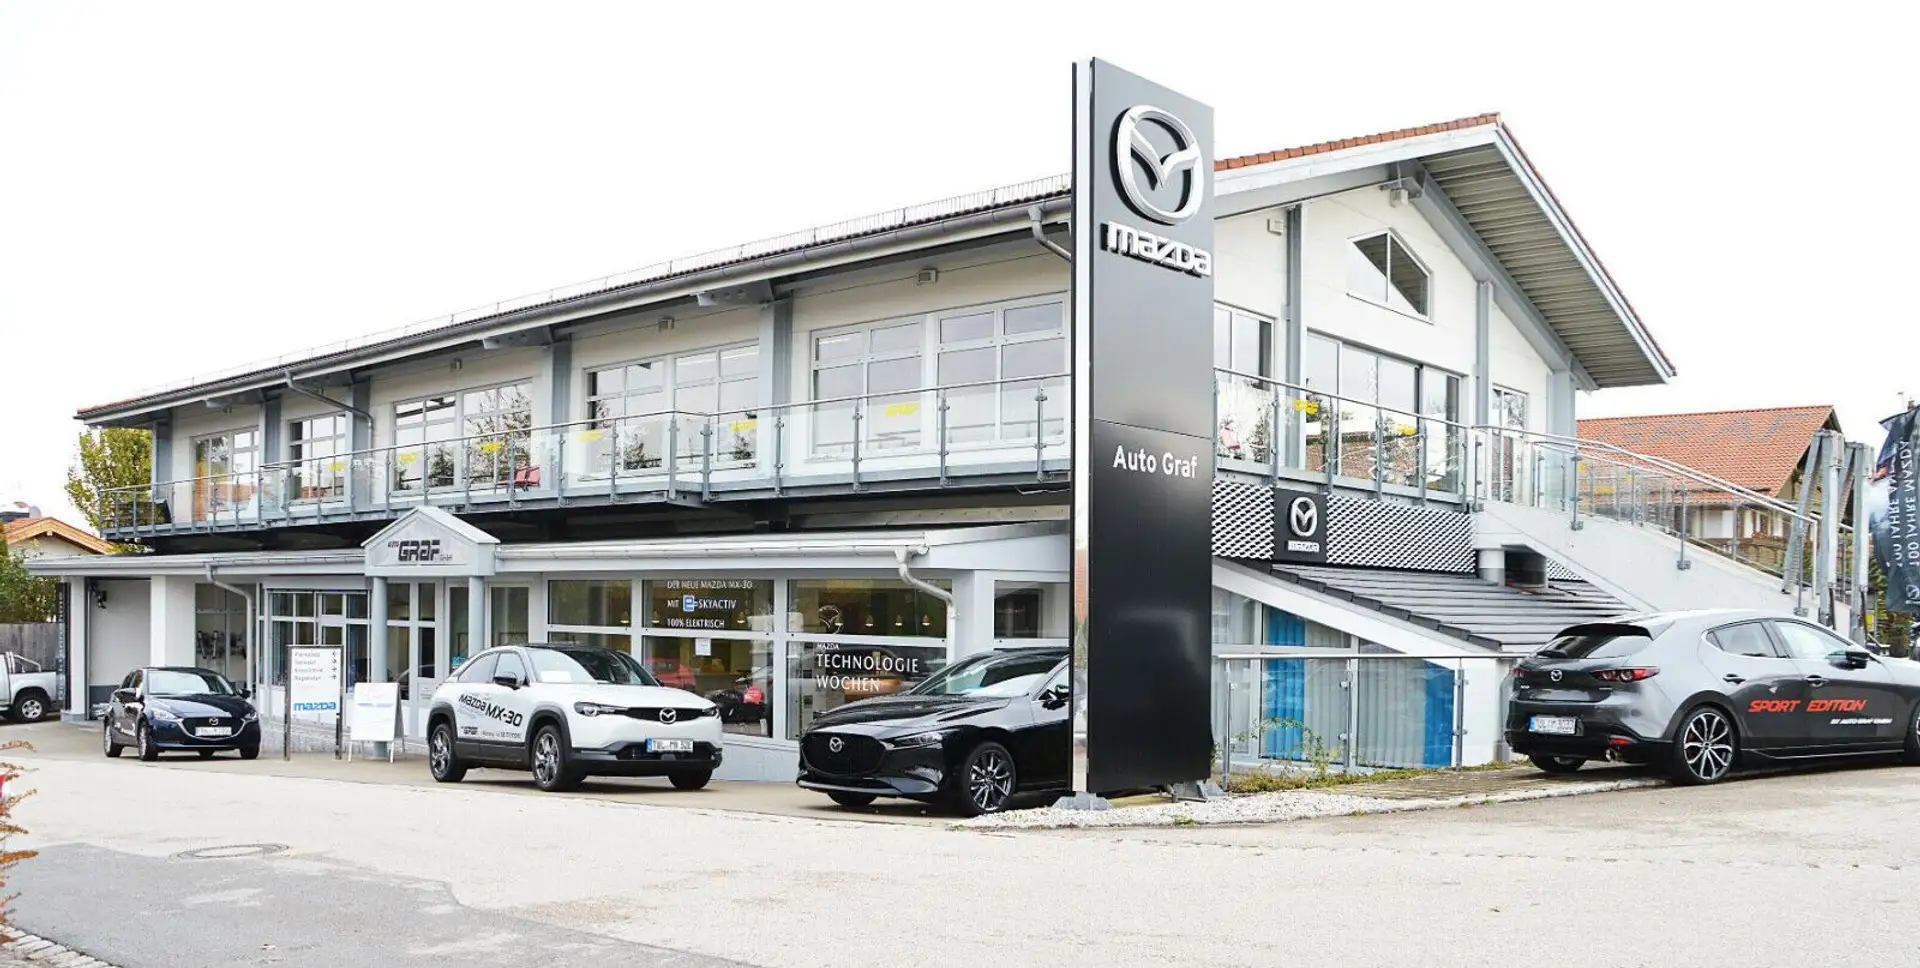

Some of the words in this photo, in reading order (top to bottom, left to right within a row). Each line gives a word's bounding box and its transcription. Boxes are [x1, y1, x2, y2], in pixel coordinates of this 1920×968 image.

[1112, 444, 1157, 474] Auto
[1162, 451, 1198, 479] Graf
[685, 618, 725, 629] ELEKTRISCH
[816, 653, 920, 674] TECHNOLOGIE
[816, 675, 881, 693] WOCHEN
[485, 702, 524, 728] MX-30
[1748, 699, 1801, 713] SPORT
[1806, 699, 1868, 713] EDITION
